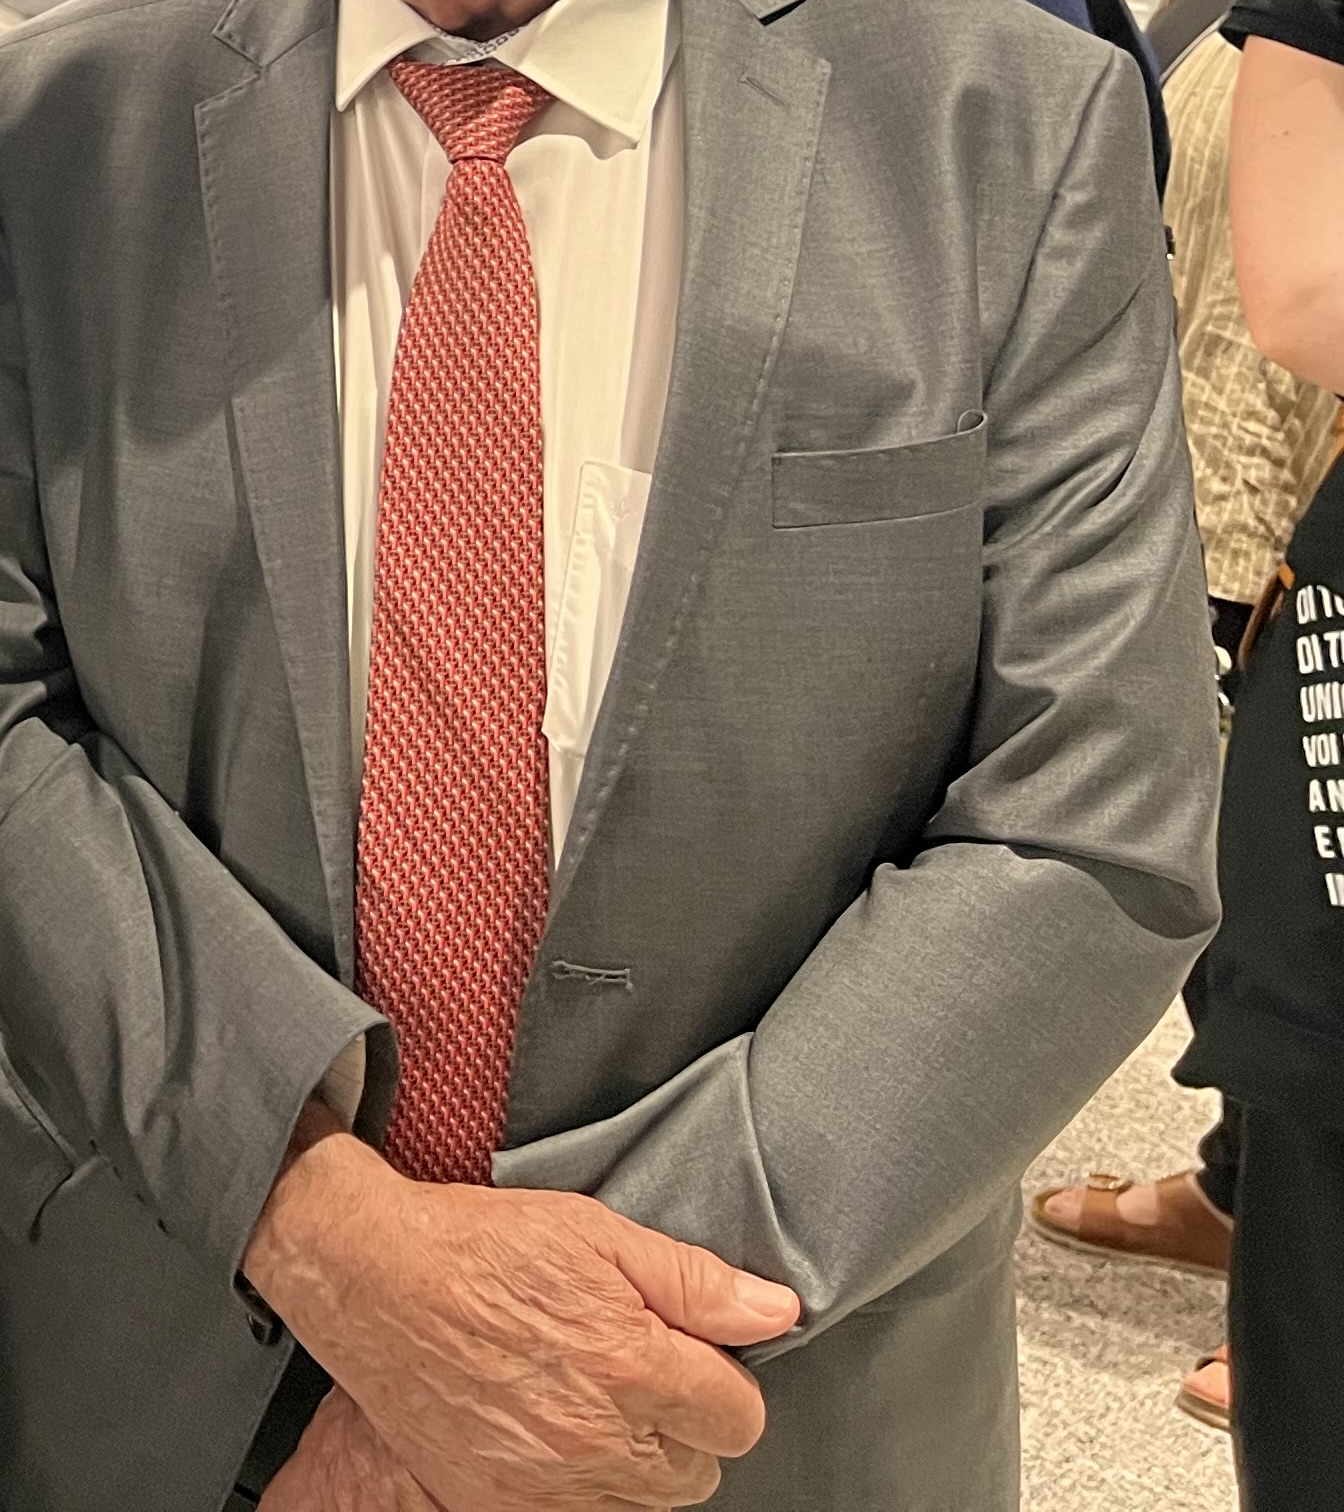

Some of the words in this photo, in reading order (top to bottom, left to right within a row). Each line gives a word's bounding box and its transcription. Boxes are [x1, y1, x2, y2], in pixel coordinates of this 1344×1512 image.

[1296, 584, 1318, 625] DI
[1296, 632, 1324, 674] DI
[1322, 630, 1344, 668] T
[1300, 681, 1344, 724] UNI
[1302, 732, 1341, 768] VOI
